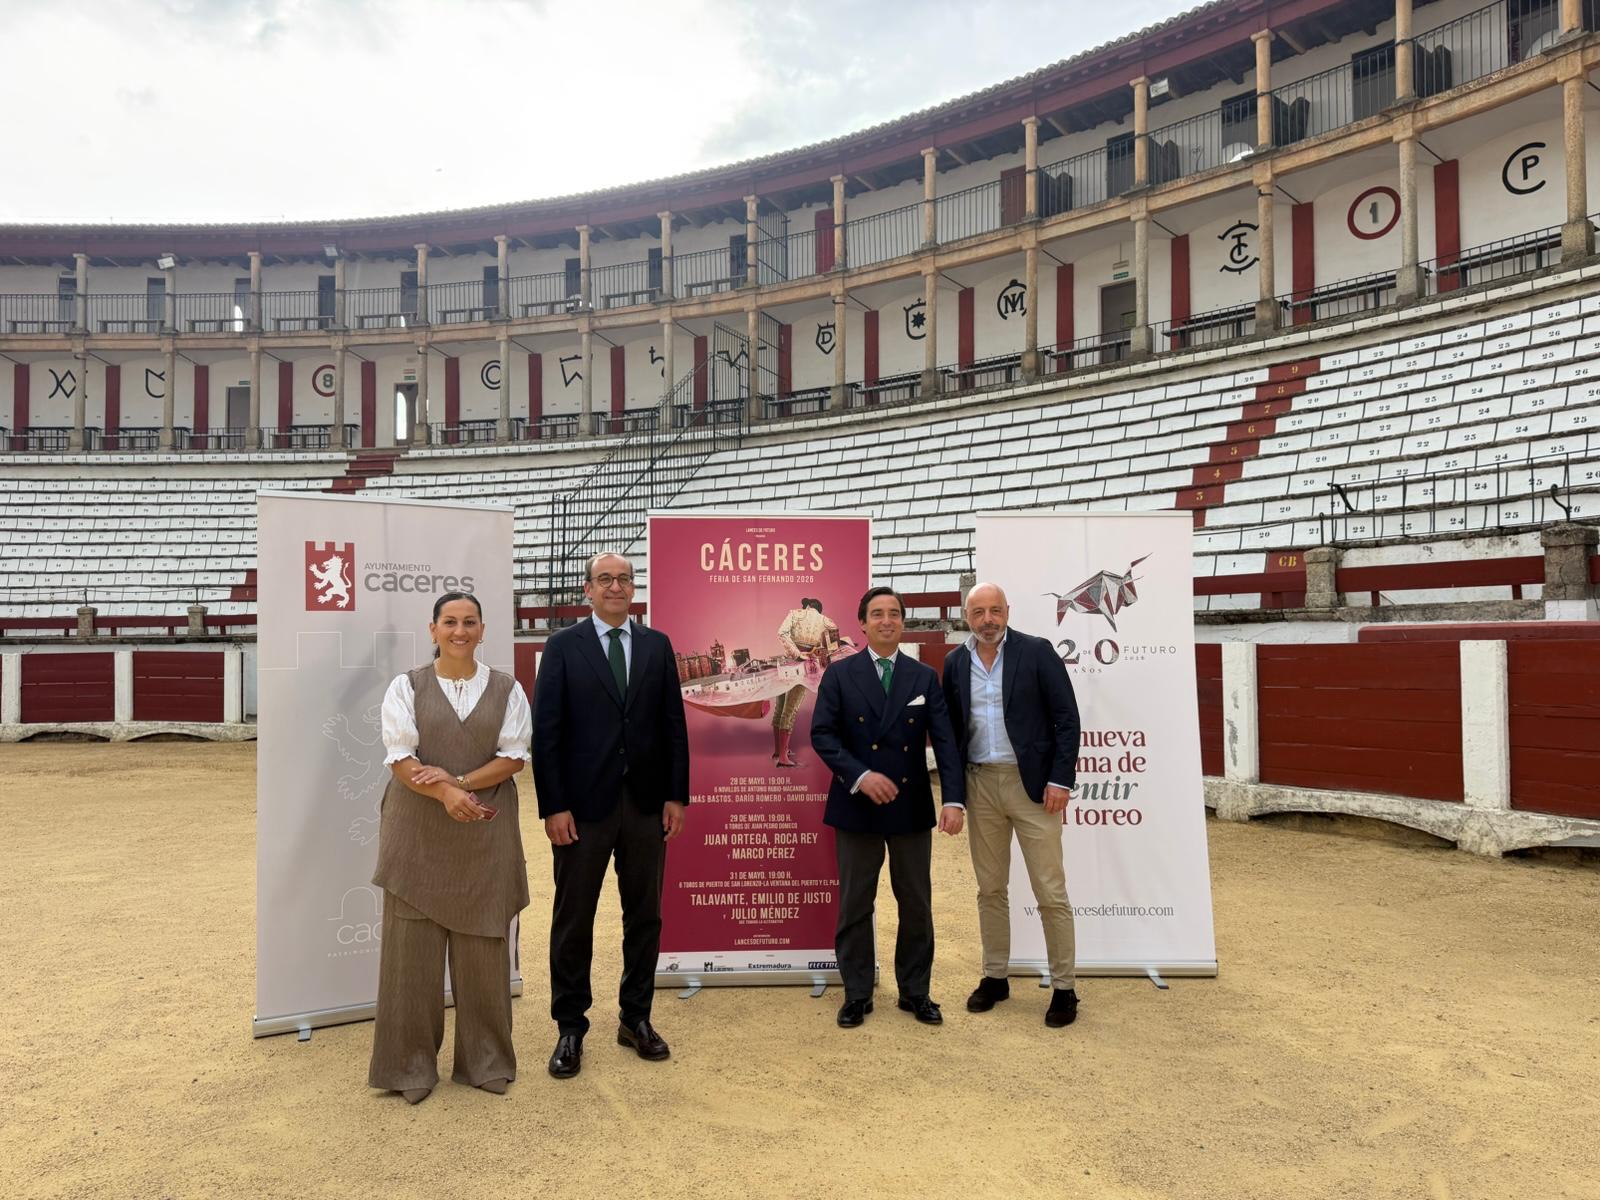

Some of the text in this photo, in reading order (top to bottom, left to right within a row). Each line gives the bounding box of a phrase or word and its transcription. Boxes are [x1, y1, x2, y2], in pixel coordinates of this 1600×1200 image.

[1369, 202, 1379, 224] 1
[323, 373, 334, 388] 8
[701, 538, 823, 571] CÁCERES
[364, 563, 431, 572] AYUNTAMIENTO
[1118, 751, 1146, 773] de
[1075, 806, 1142, 825] toreo
[704, 833, 818, 845] JUAN ORTEGA, ROCA REY
[732, 848, 764, 859] MARCO
[767, 846, 795, 859] PÉREZ
[691, 892, 832, 906] TALAVANTE, EMILIO DE JUSTO
[731, 906, 800, 920] JULIO MÉNDEZ
